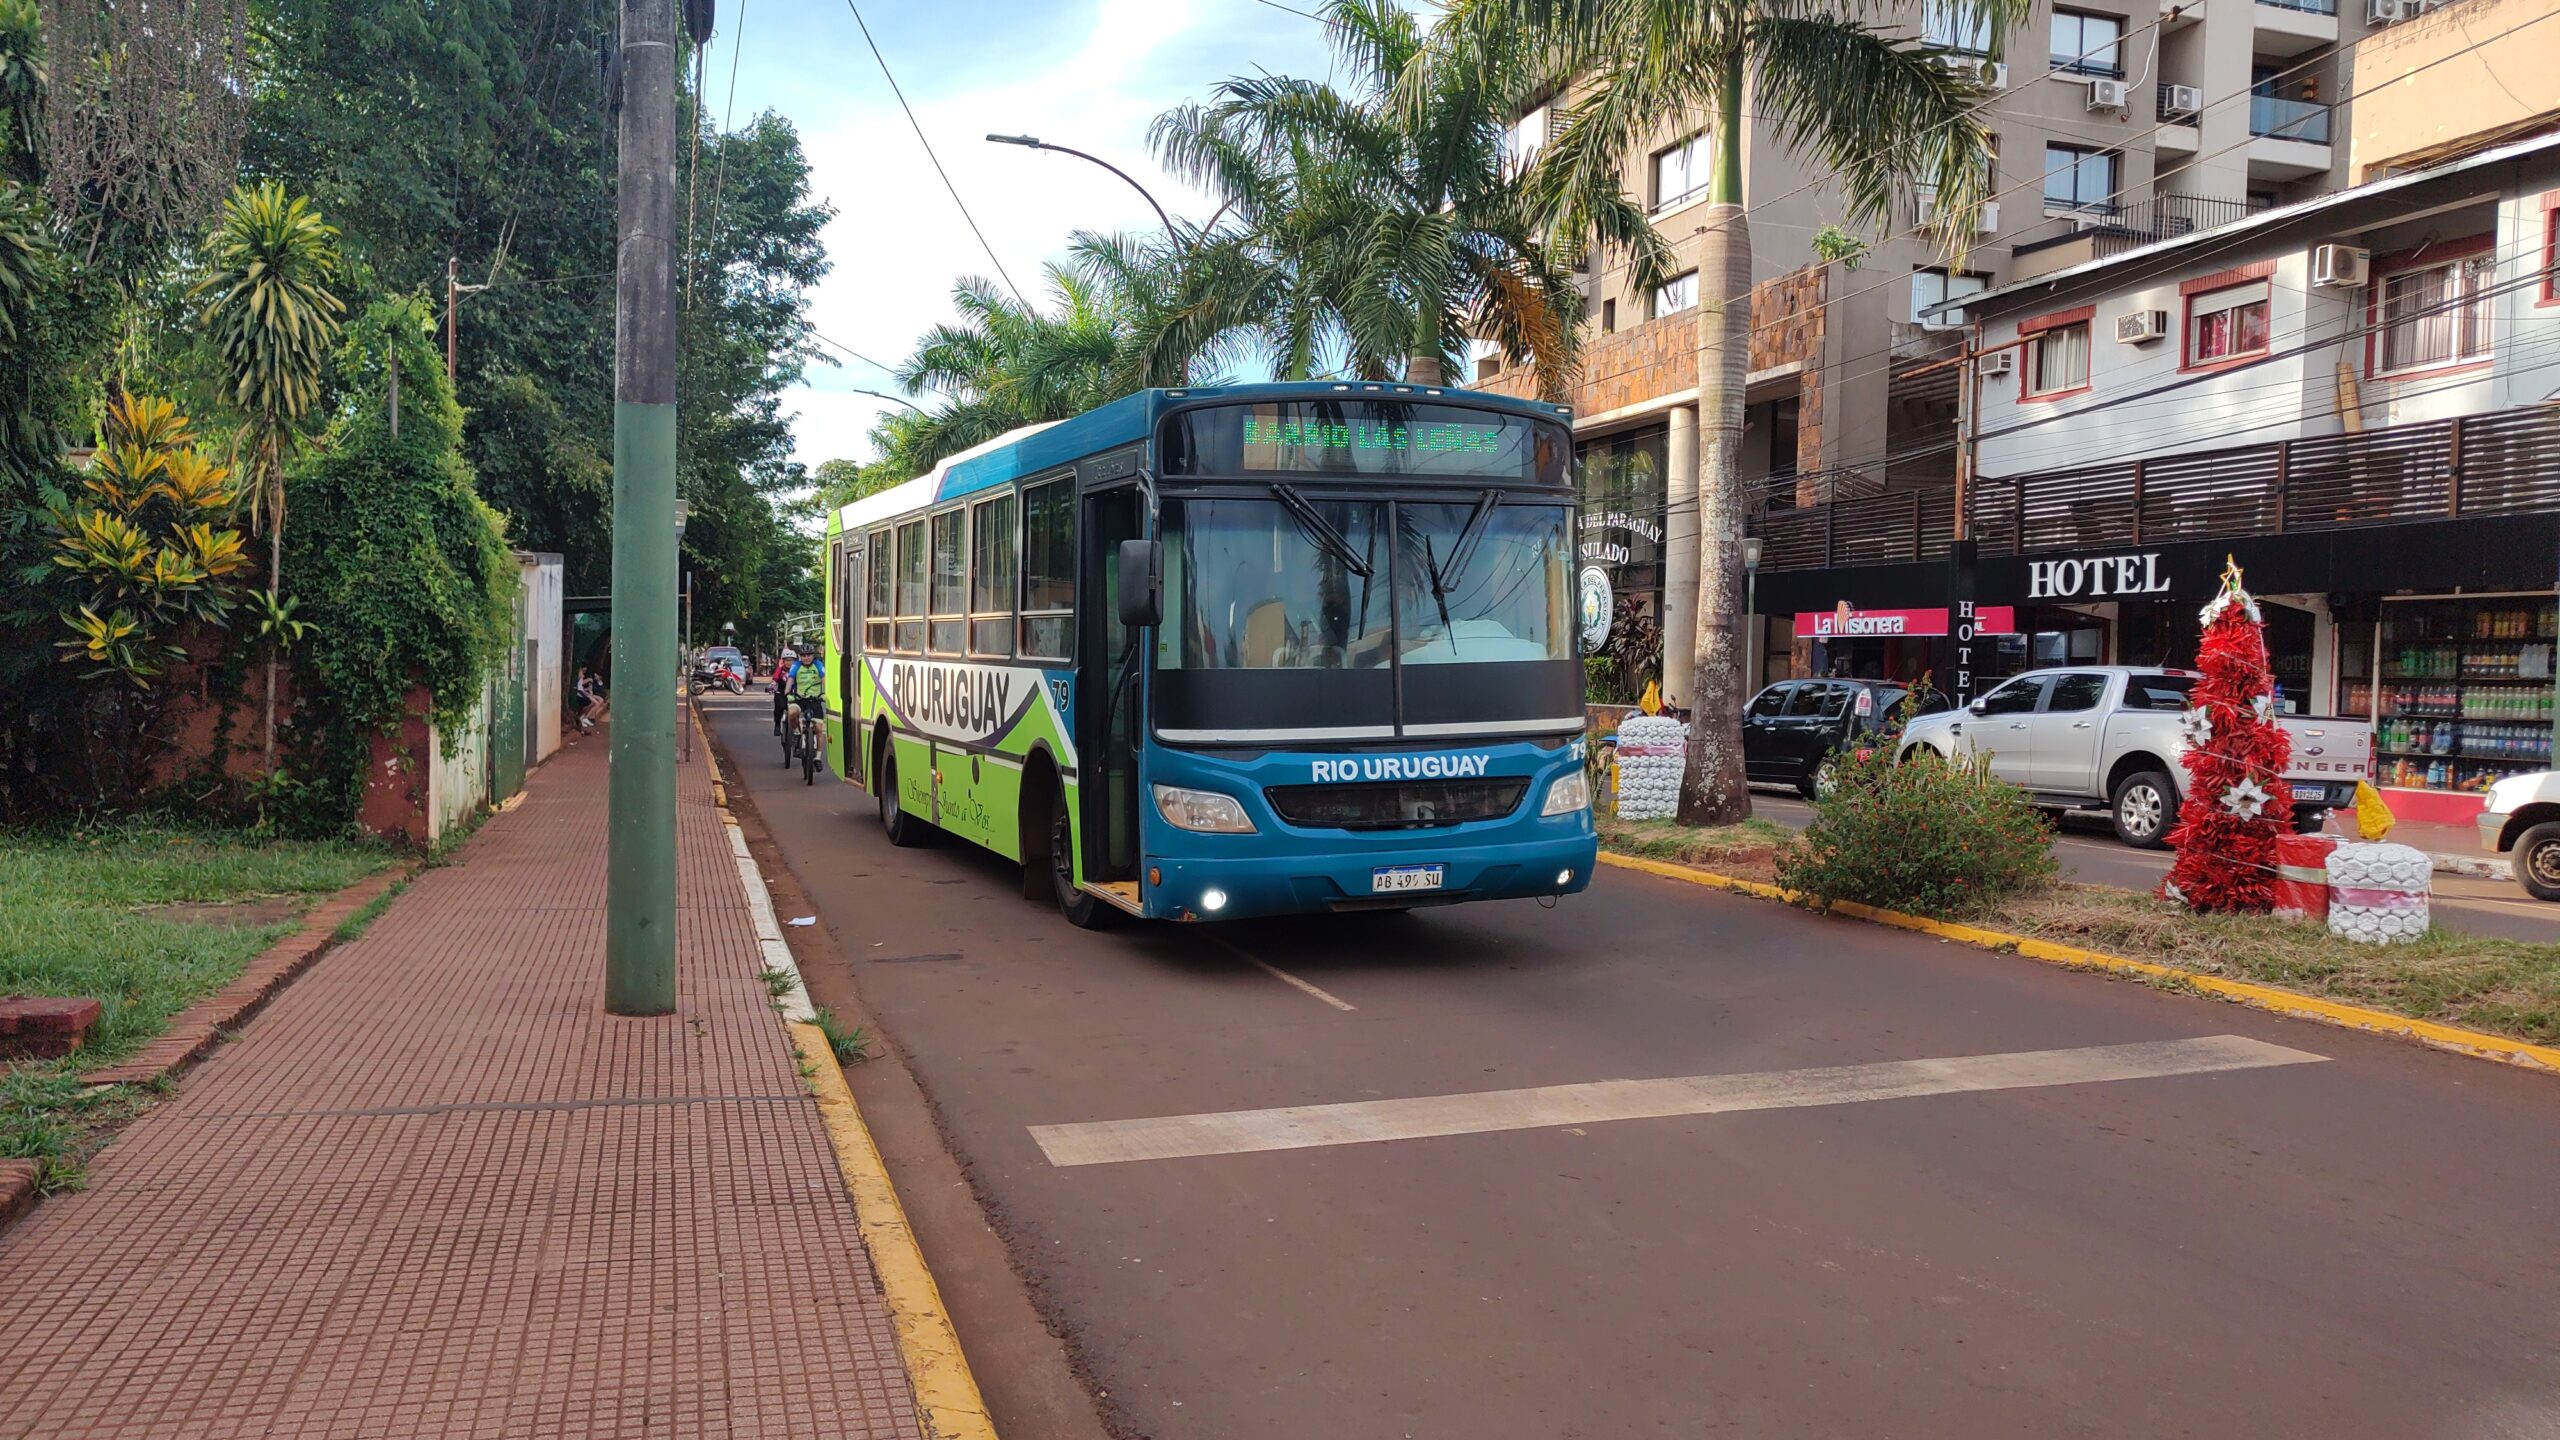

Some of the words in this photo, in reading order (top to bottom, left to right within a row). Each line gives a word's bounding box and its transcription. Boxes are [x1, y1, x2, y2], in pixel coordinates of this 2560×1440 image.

[1244, 421, 1351, 449] BARRIO
[1358, 425, 1409, 450] LAS
[1417, 424, 1499, 453] LEÑAS
[1586, 513, 1606, 529] DEL
[1607, 511, 1663, 543] PARAGUAY
[1578, 541, 1630, 564] SULADO
[2027, 553, 2171, 598] HOTEL
[1814, 613, 1832, 635] La
[892, 663, 917, 718] RIO
[920, 665, 1010, 734] URUGUAY
[1051, 679, 1069, 712] 79
[1312, 759, 1358, 783] RIO
[1363, 754, 1490, 780] URUGUAY
[2290, 761, 2366, 773] NGER
[1376, 875, 1392, 889] AB
[1424, 873, 1439, 887] SU
